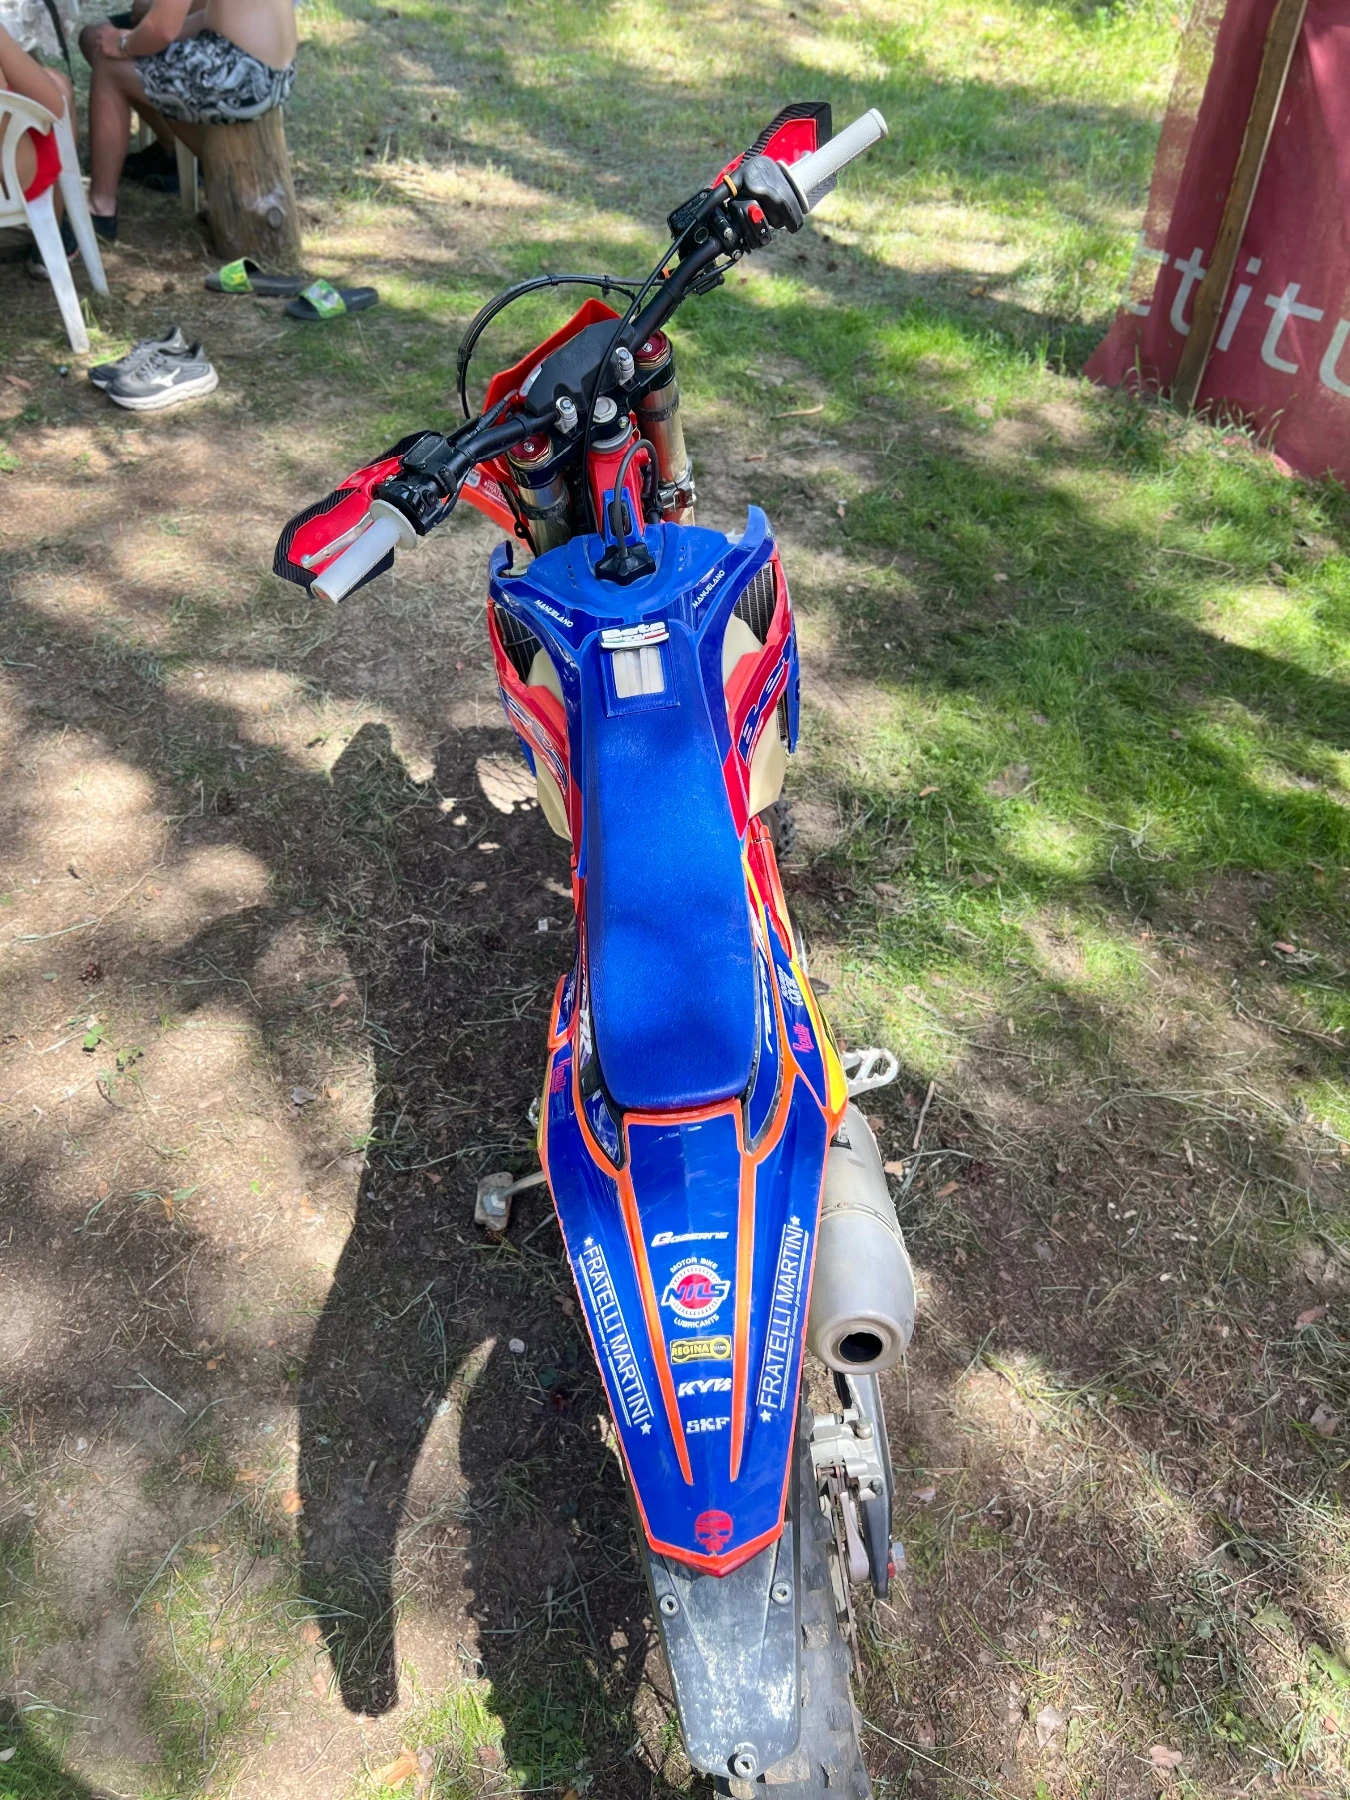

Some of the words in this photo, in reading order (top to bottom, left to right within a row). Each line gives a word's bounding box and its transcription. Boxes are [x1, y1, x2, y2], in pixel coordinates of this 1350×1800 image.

[692, 569, 725, 609] MANUELANO
[534, 599, 574, 628] MANUELANO
[670, 1257, 698, 1273] MOTOR
[700, 1257, 718, 1270] BIKE
[776, 1225, 804, 1305] MARTINI
[661, 1281, 730, 1306] NILS
[674, 1313, 720, 1328] LUBRICANTS
[584, 1246, 622, 1333] FRATELLI
[610, 1332, 650, 1425] MARTINI
[671, 1343, 710, 1357] REGINA
[760, 1306, 793, 1409] FRATELLI
[677, 1377, 732, 1398] KYB
[686, 1416, 730, 1434] SKF
